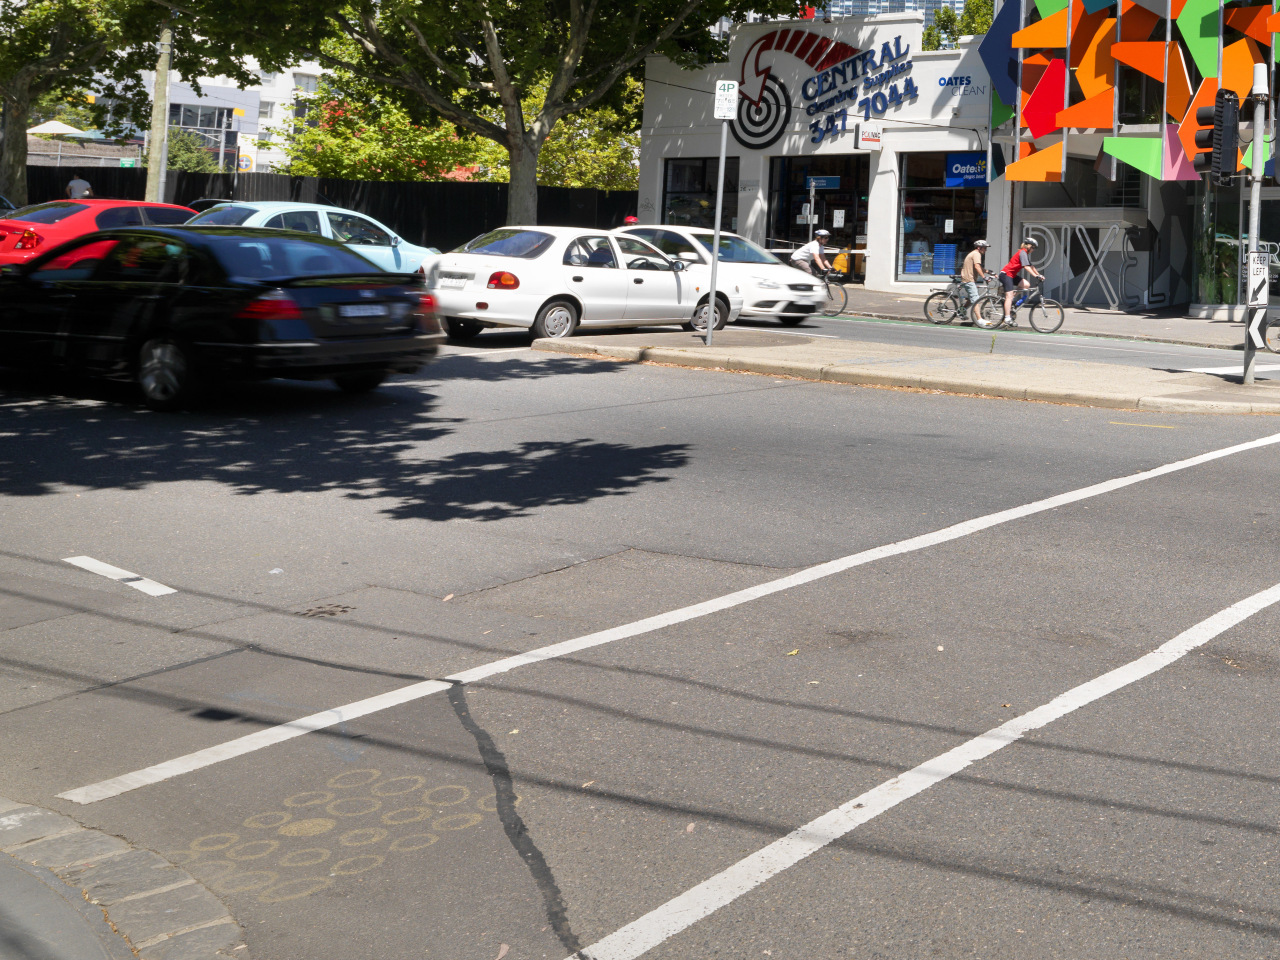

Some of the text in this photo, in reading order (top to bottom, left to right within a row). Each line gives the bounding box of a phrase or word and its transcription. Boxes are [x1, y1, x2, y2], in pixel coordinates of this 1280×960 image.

[801, 35, 910, 100] CENTRAL
[938, 76, 971, 86] OATES
[718, 83, 735, 92] 4P
[806, 60, 913, 116] Cleaning Supplies
[951, 85, 985, 96] CLEAN
[809, 76, 919, 143] 347 7044
[952, 163, 981, 173] Oates
[1021, 224, 1166, 306] PIXEL
[1252, 256, 1267, 265] KEEP
[1252, 267, 1266, 276] LEFT
